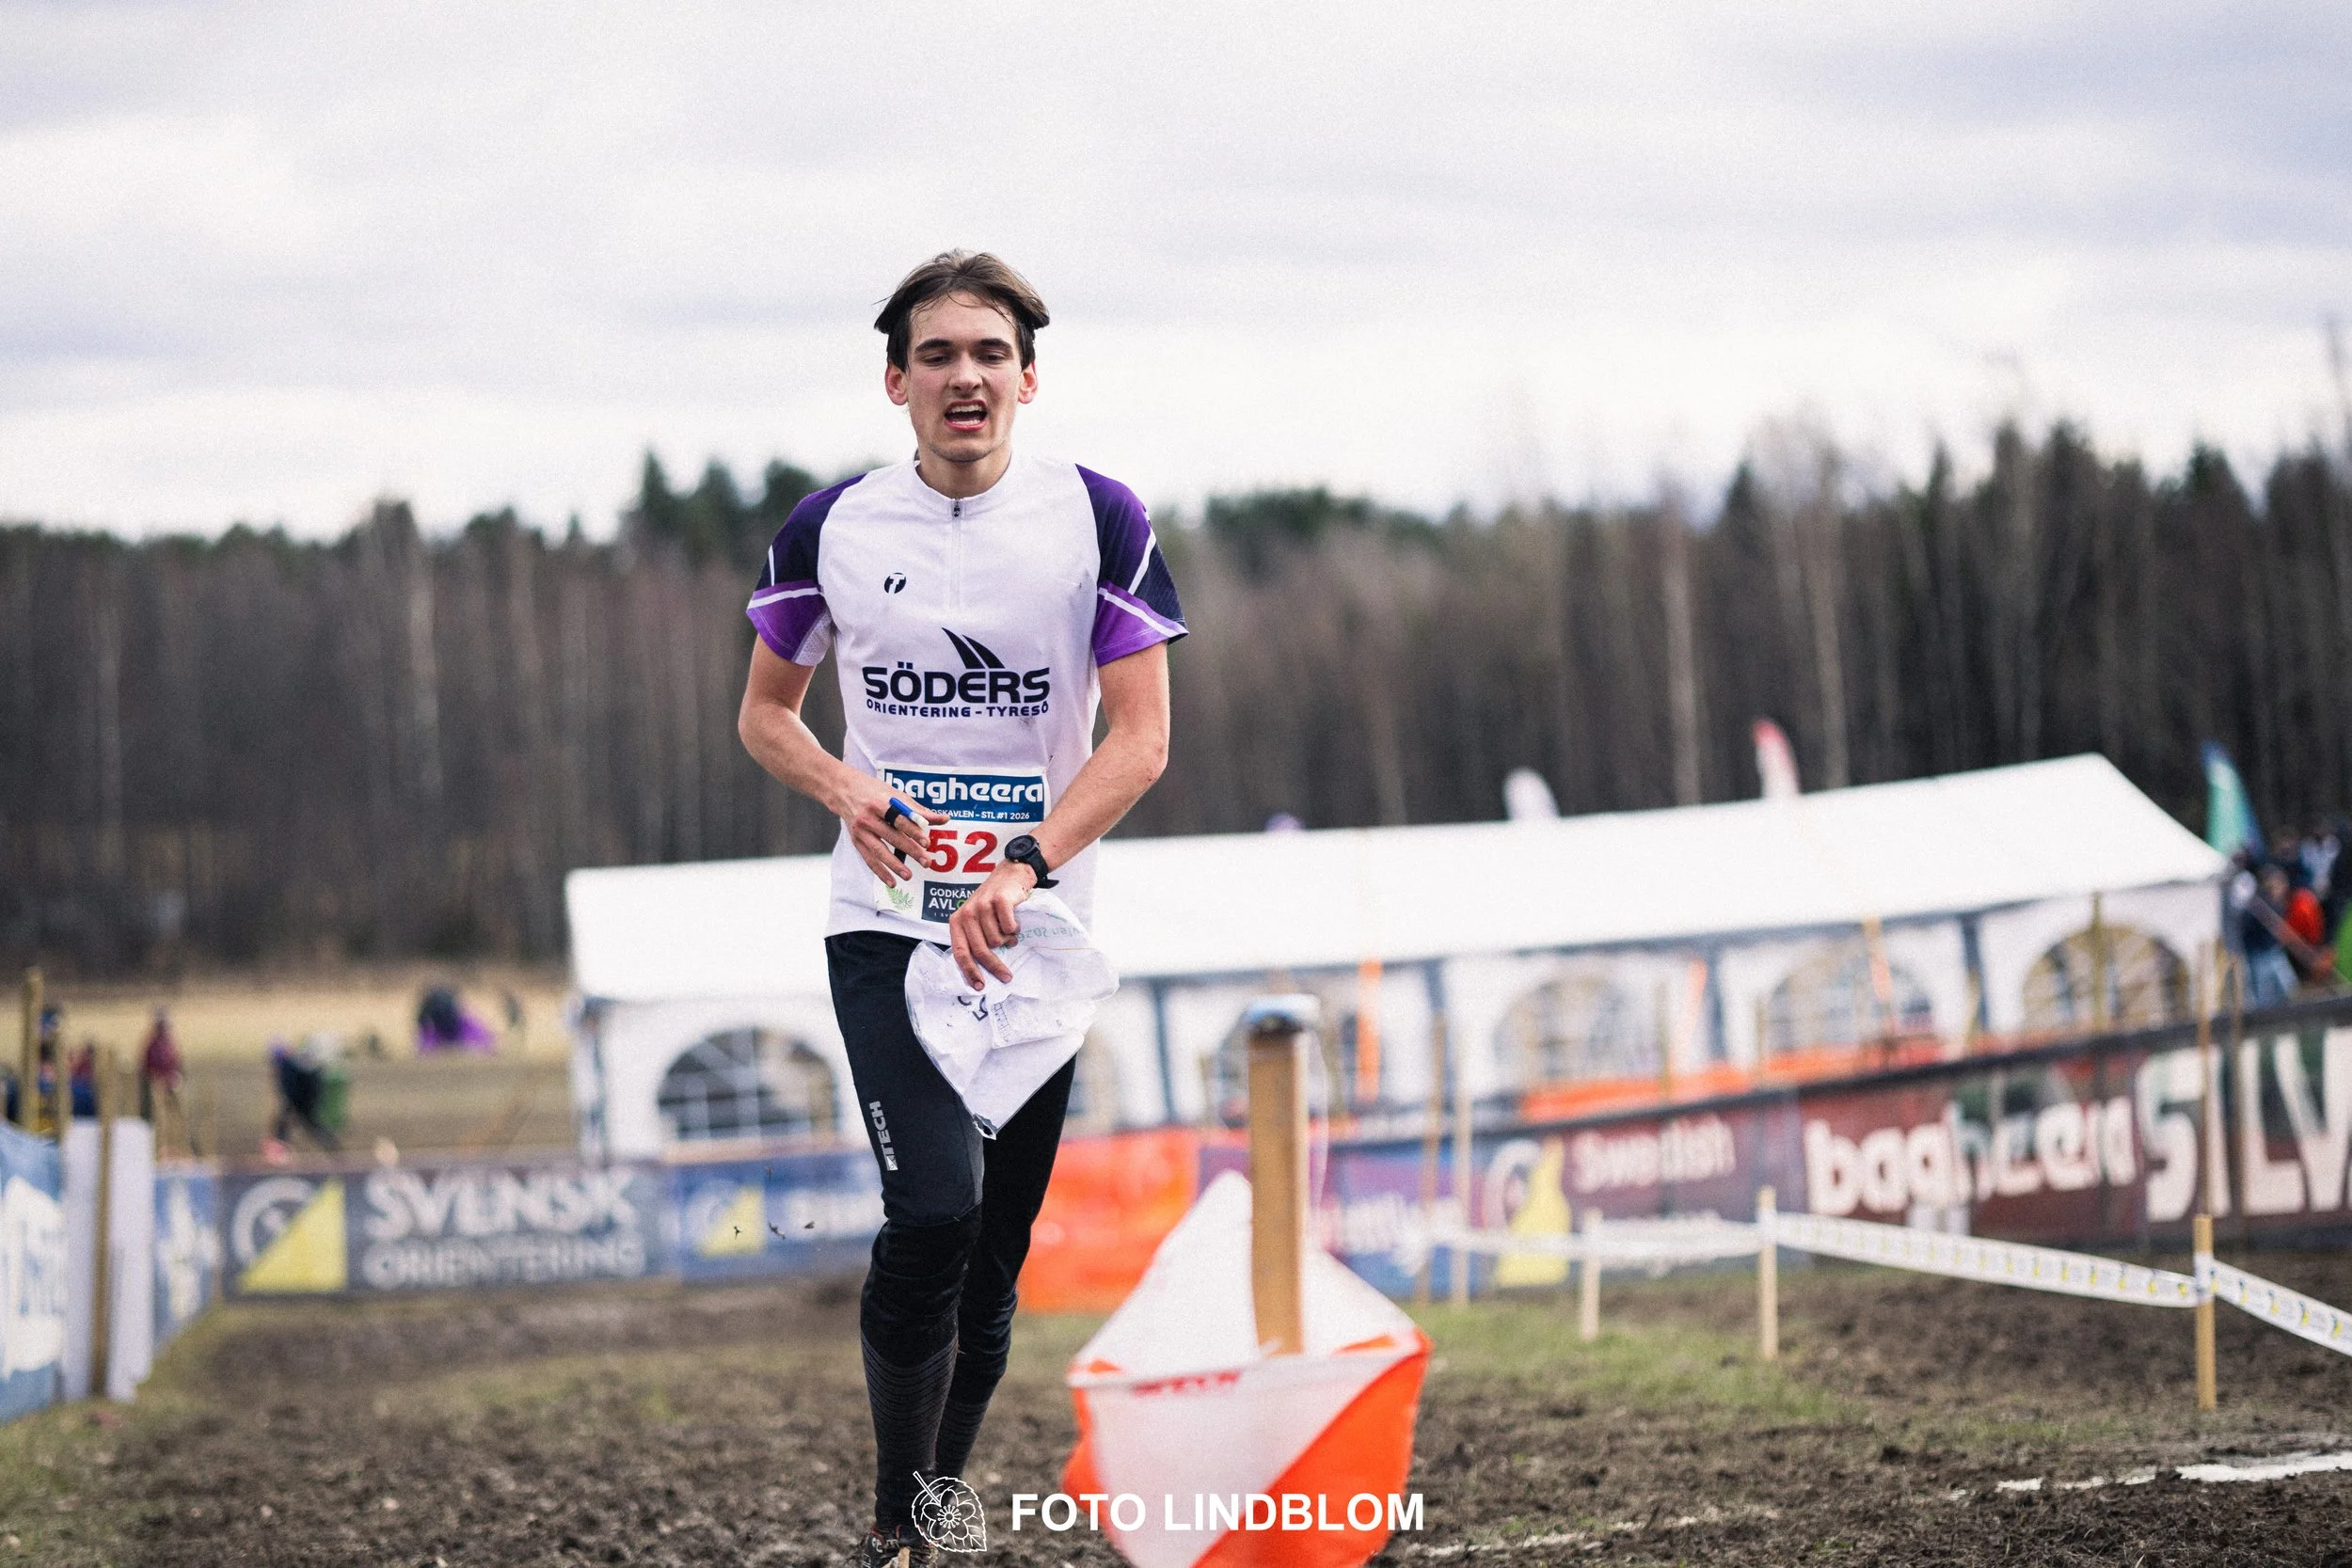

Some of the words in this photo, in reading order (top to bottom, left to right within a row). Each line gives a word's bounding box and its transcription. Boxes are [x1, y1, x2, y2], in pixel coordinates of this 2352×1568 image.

[862, 661, 1050, 704] SÖDERS
[866, 699, 971, 718] ORIENTERING
[988, 701, 1049, 718] TYRESÖ
[886, 772, 1043, 804] bagheera
[930, 808, 975, 818] SKAVLEN
[981, 811, 996, 819] STL
[997, 811, 1008, 819] #1
[1009, 812, 1030, 820] 2026
[926, 830, 998, 873] 52
[930, 887, 975, 899] GODKÄN
[2137, 1027, 2352, 1222] SILV
[366, 1168, 636, 1241] SVENSK
